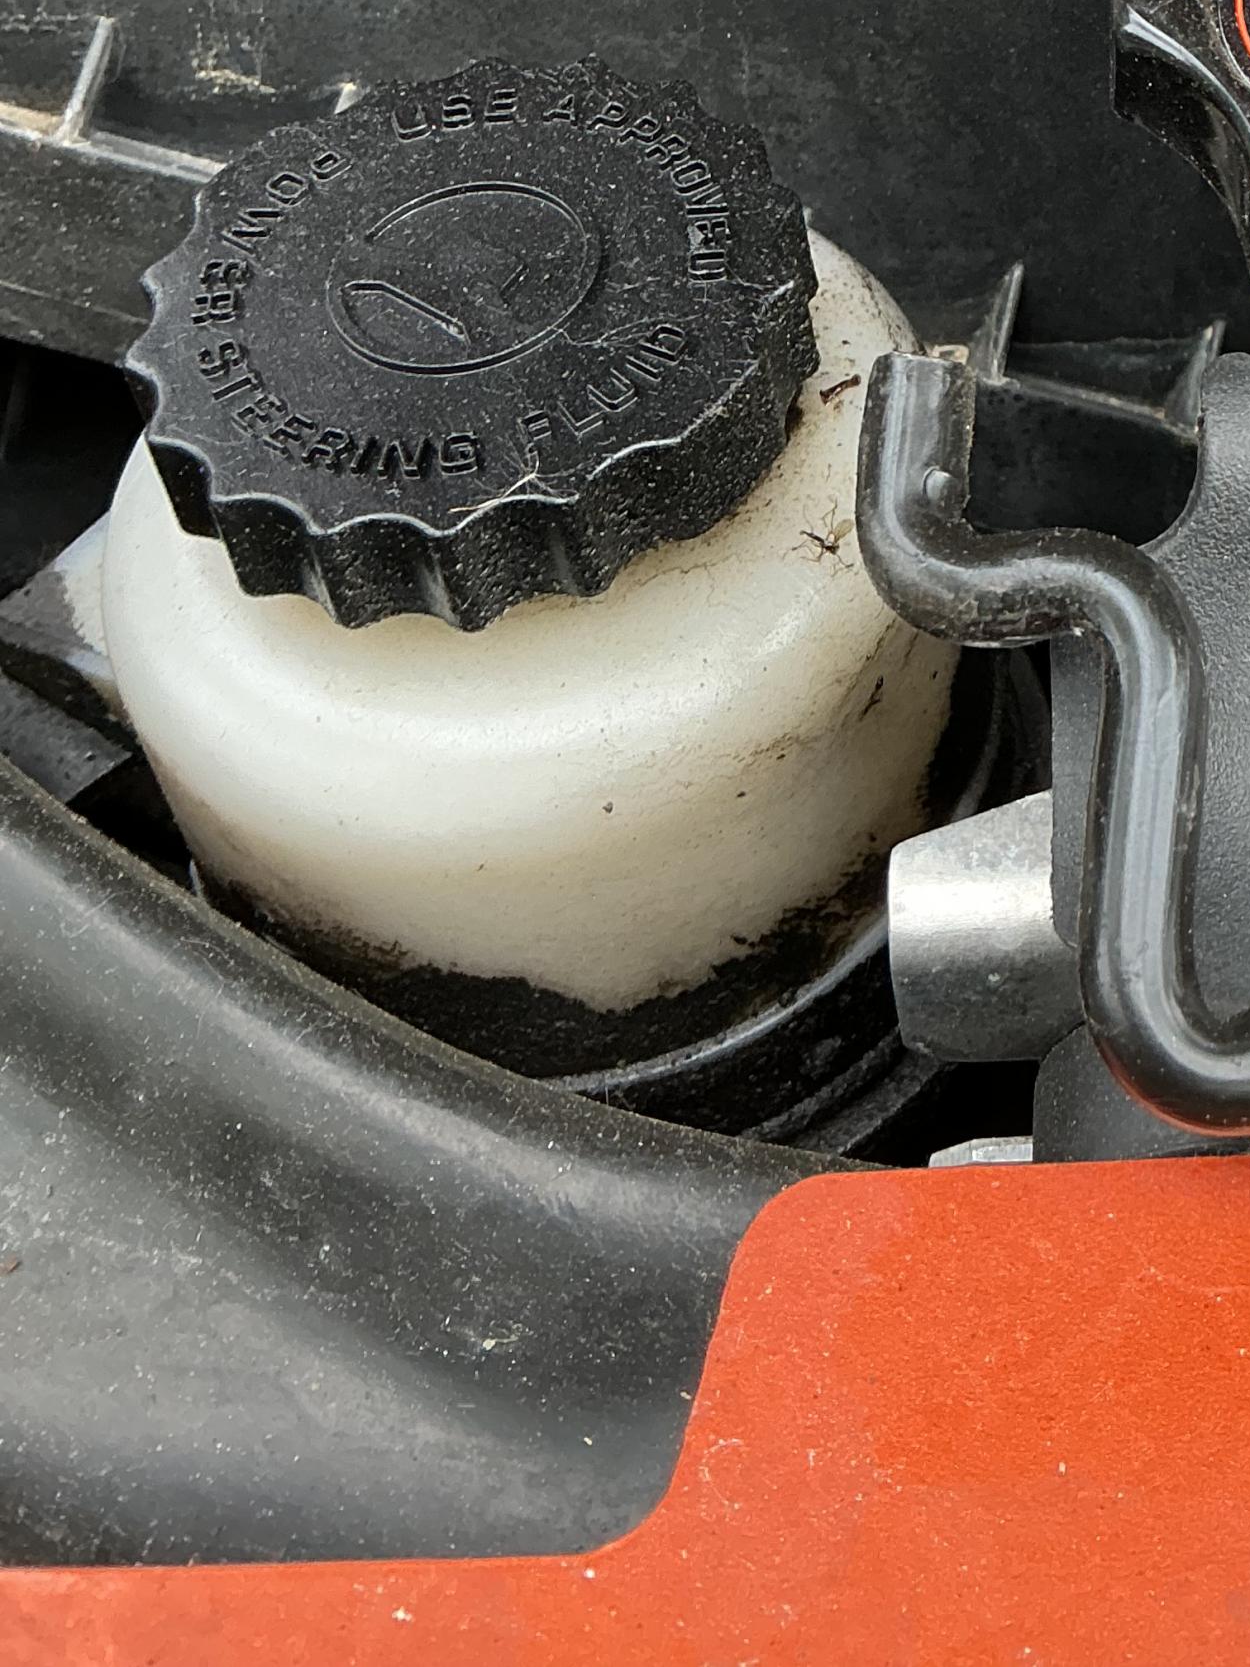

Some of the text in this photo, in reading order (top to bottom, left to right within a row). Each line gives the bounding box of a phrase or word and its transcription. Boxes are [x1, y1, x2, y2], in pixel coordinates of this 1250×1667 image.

[190, 150, 687, 482] POWER STEERING FLUID
[391, 87, 731, 284] USE APPROVED
